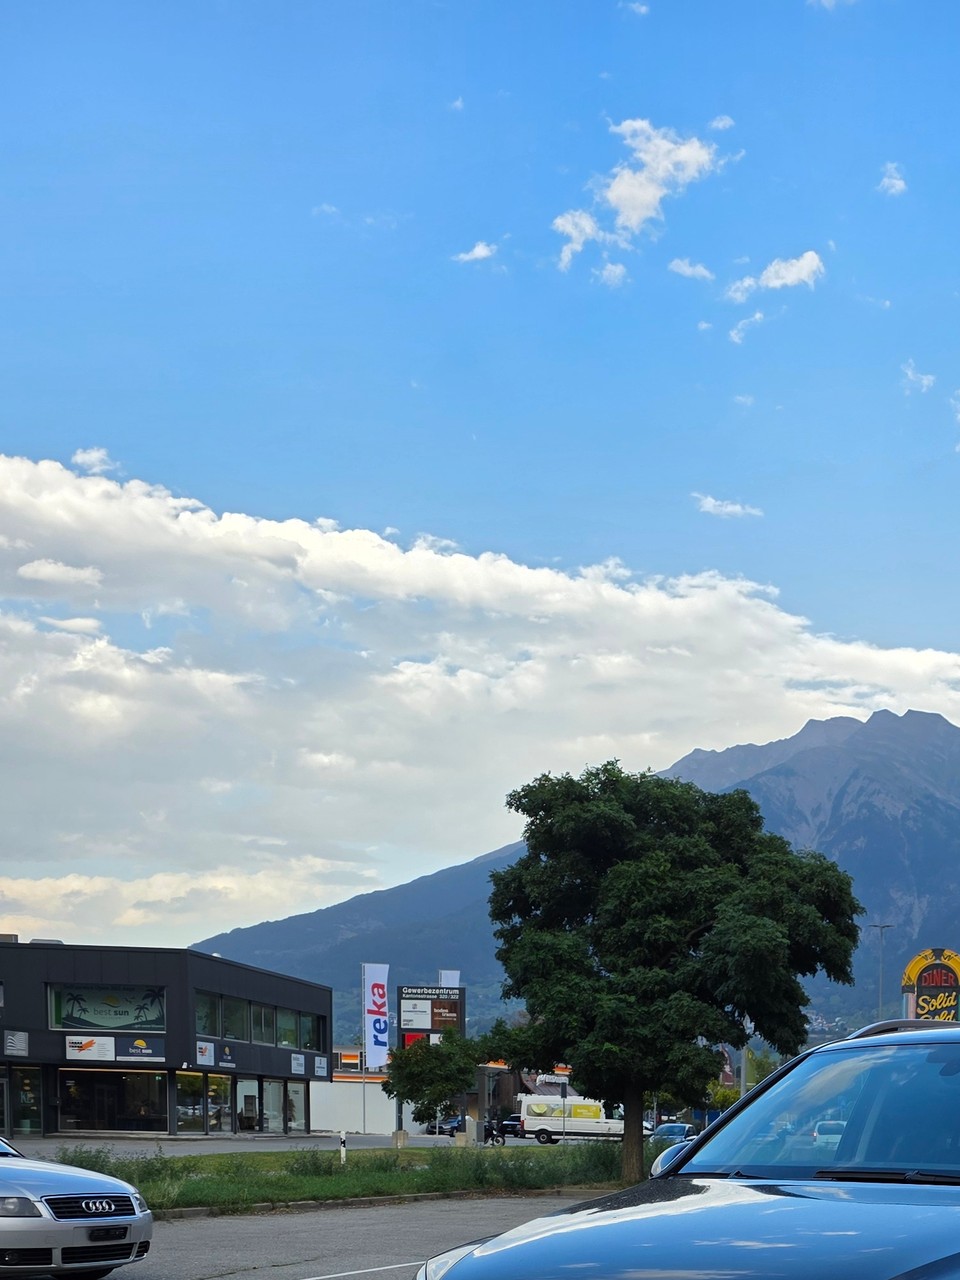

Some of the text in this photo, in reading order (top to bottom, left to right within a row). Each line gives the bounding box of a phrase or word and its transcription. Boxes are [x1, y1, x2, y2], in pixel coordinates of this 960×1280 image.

[921, 968, 956, 986] DINER
[93, 1008, 112, 1016] best
[916, 992, 957, 1015] Solid
[367, 983, 388, 1047] reka
